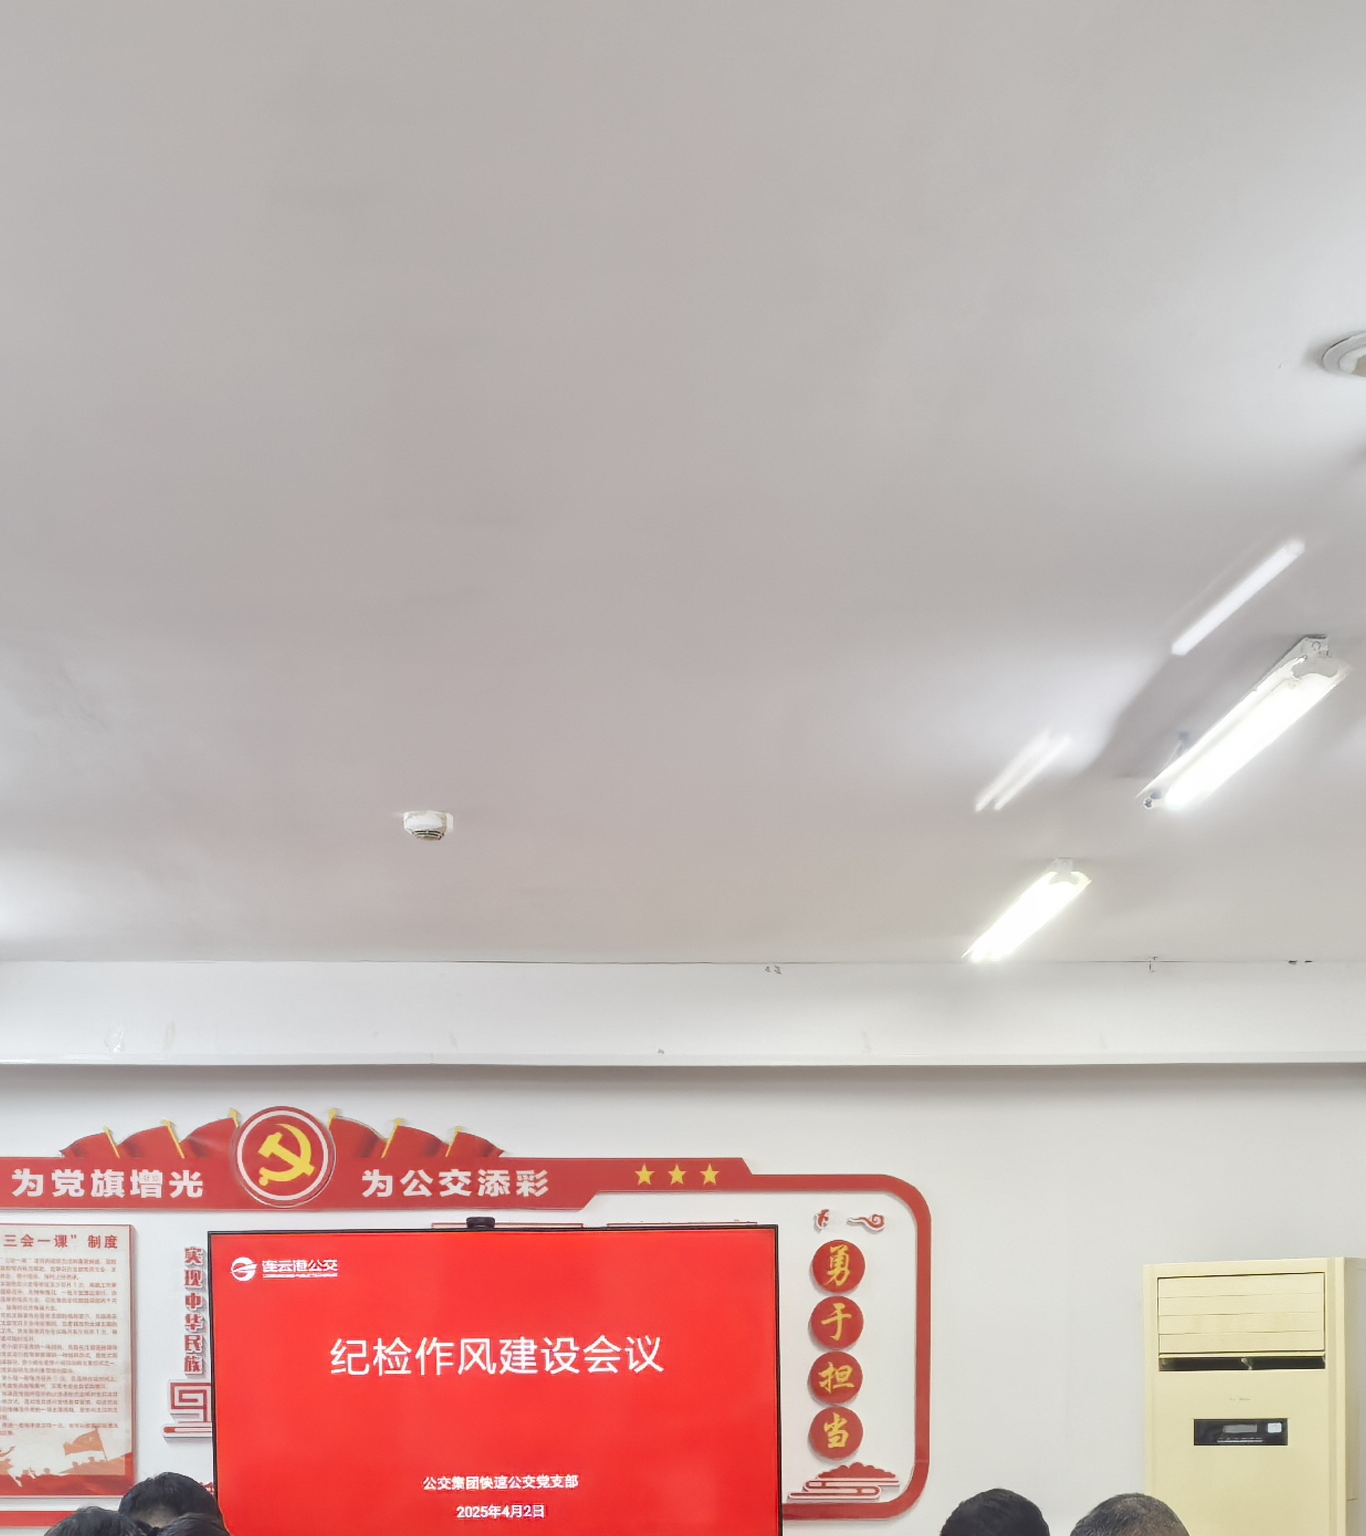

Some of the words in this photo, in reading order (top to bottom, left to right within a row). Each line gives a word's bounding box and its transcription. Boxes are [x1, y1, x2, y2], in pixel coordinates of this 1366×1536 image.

[11, 1168, 203, 1199] 为党旗增光
[362, 1168, 549, 1198] 为公交添彩
[184, 1246, 203, 1374] 实现中华民族
[330, 1334, 665, 1377] 纪检作风建设会议
[819, 1244, 856, 1449] 勇于担当
[423, 1474, 579, 1491] 公交集团快速公交党支部
[455, 1504, 546, 1520] 2025年4月2日
